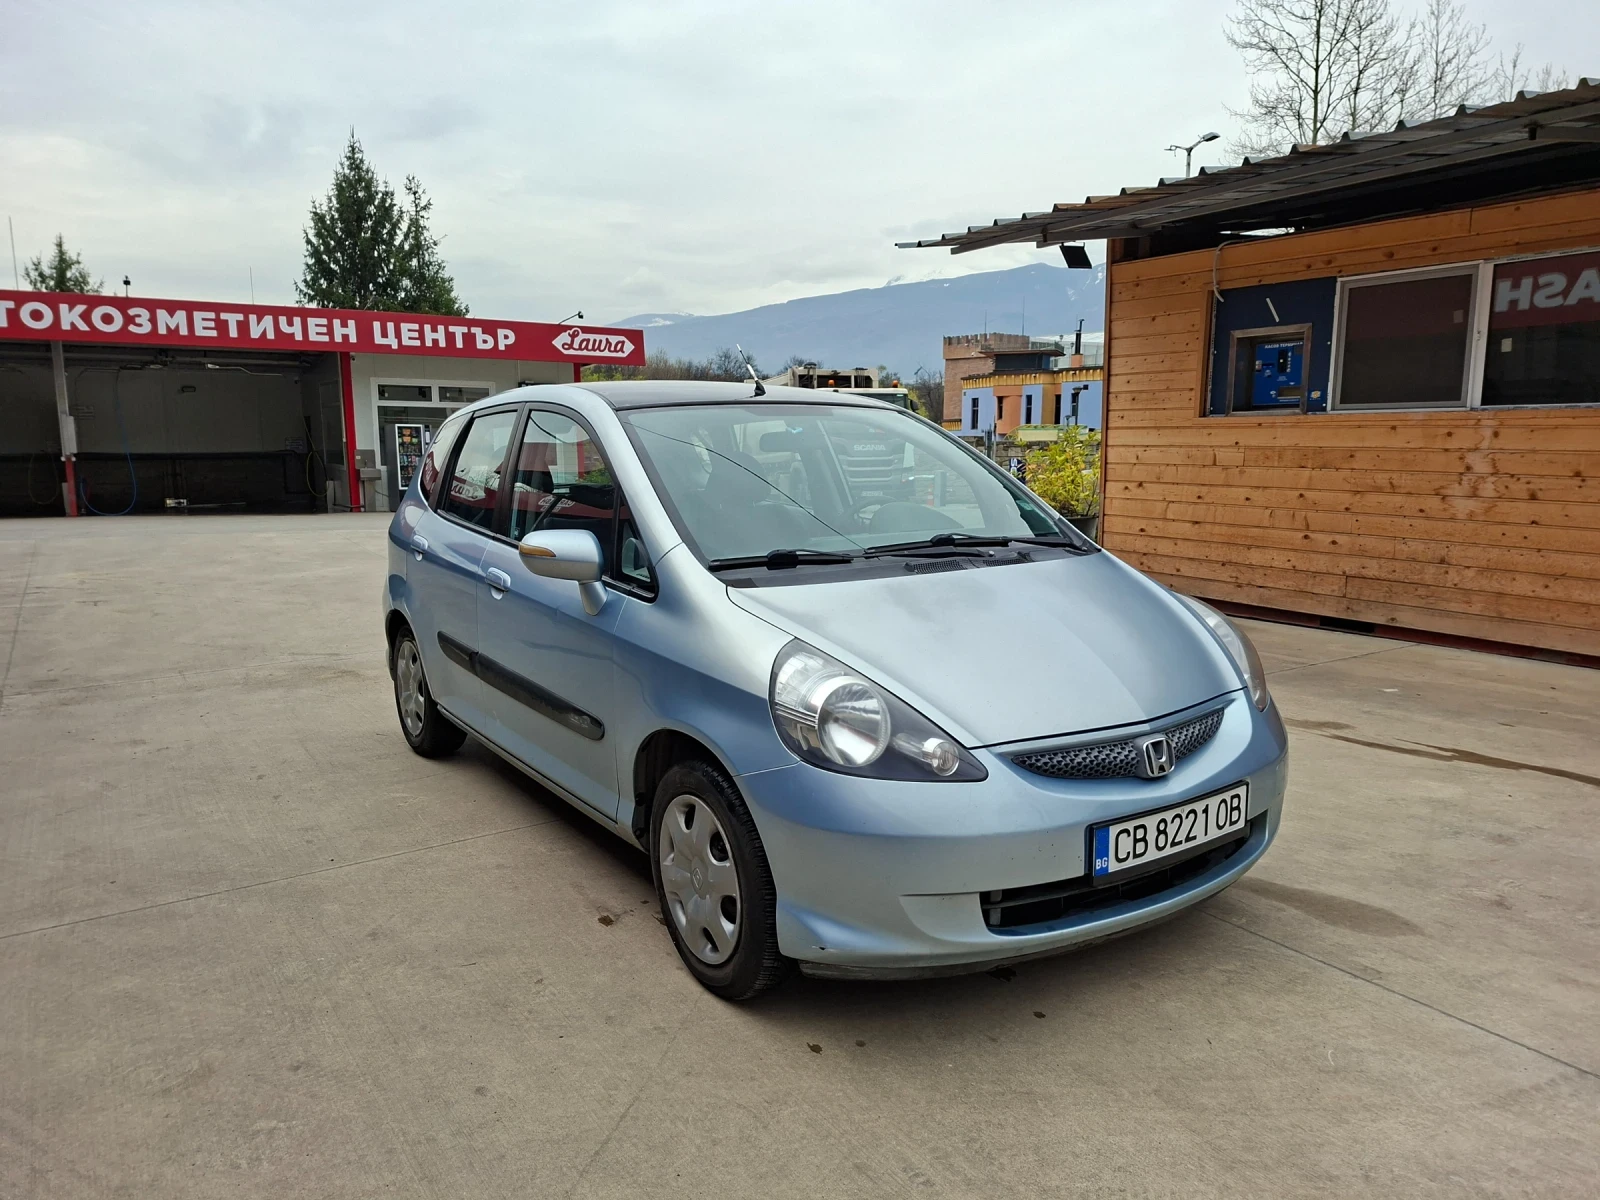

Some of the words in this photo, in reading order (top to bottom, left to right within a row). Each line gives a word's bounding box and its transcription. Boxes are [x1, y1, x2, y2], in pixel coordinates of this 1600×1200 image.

[373, 321, 516, 351] ЦЕНТЪР
[562, 329, 625, 353] Laura
[1115, 824, 1149, 864] CB
[1155, 804, 1210, 852] 8221
[1216, 793, 1242, 831] OB
[1096, 857, 1108, 870] BG
